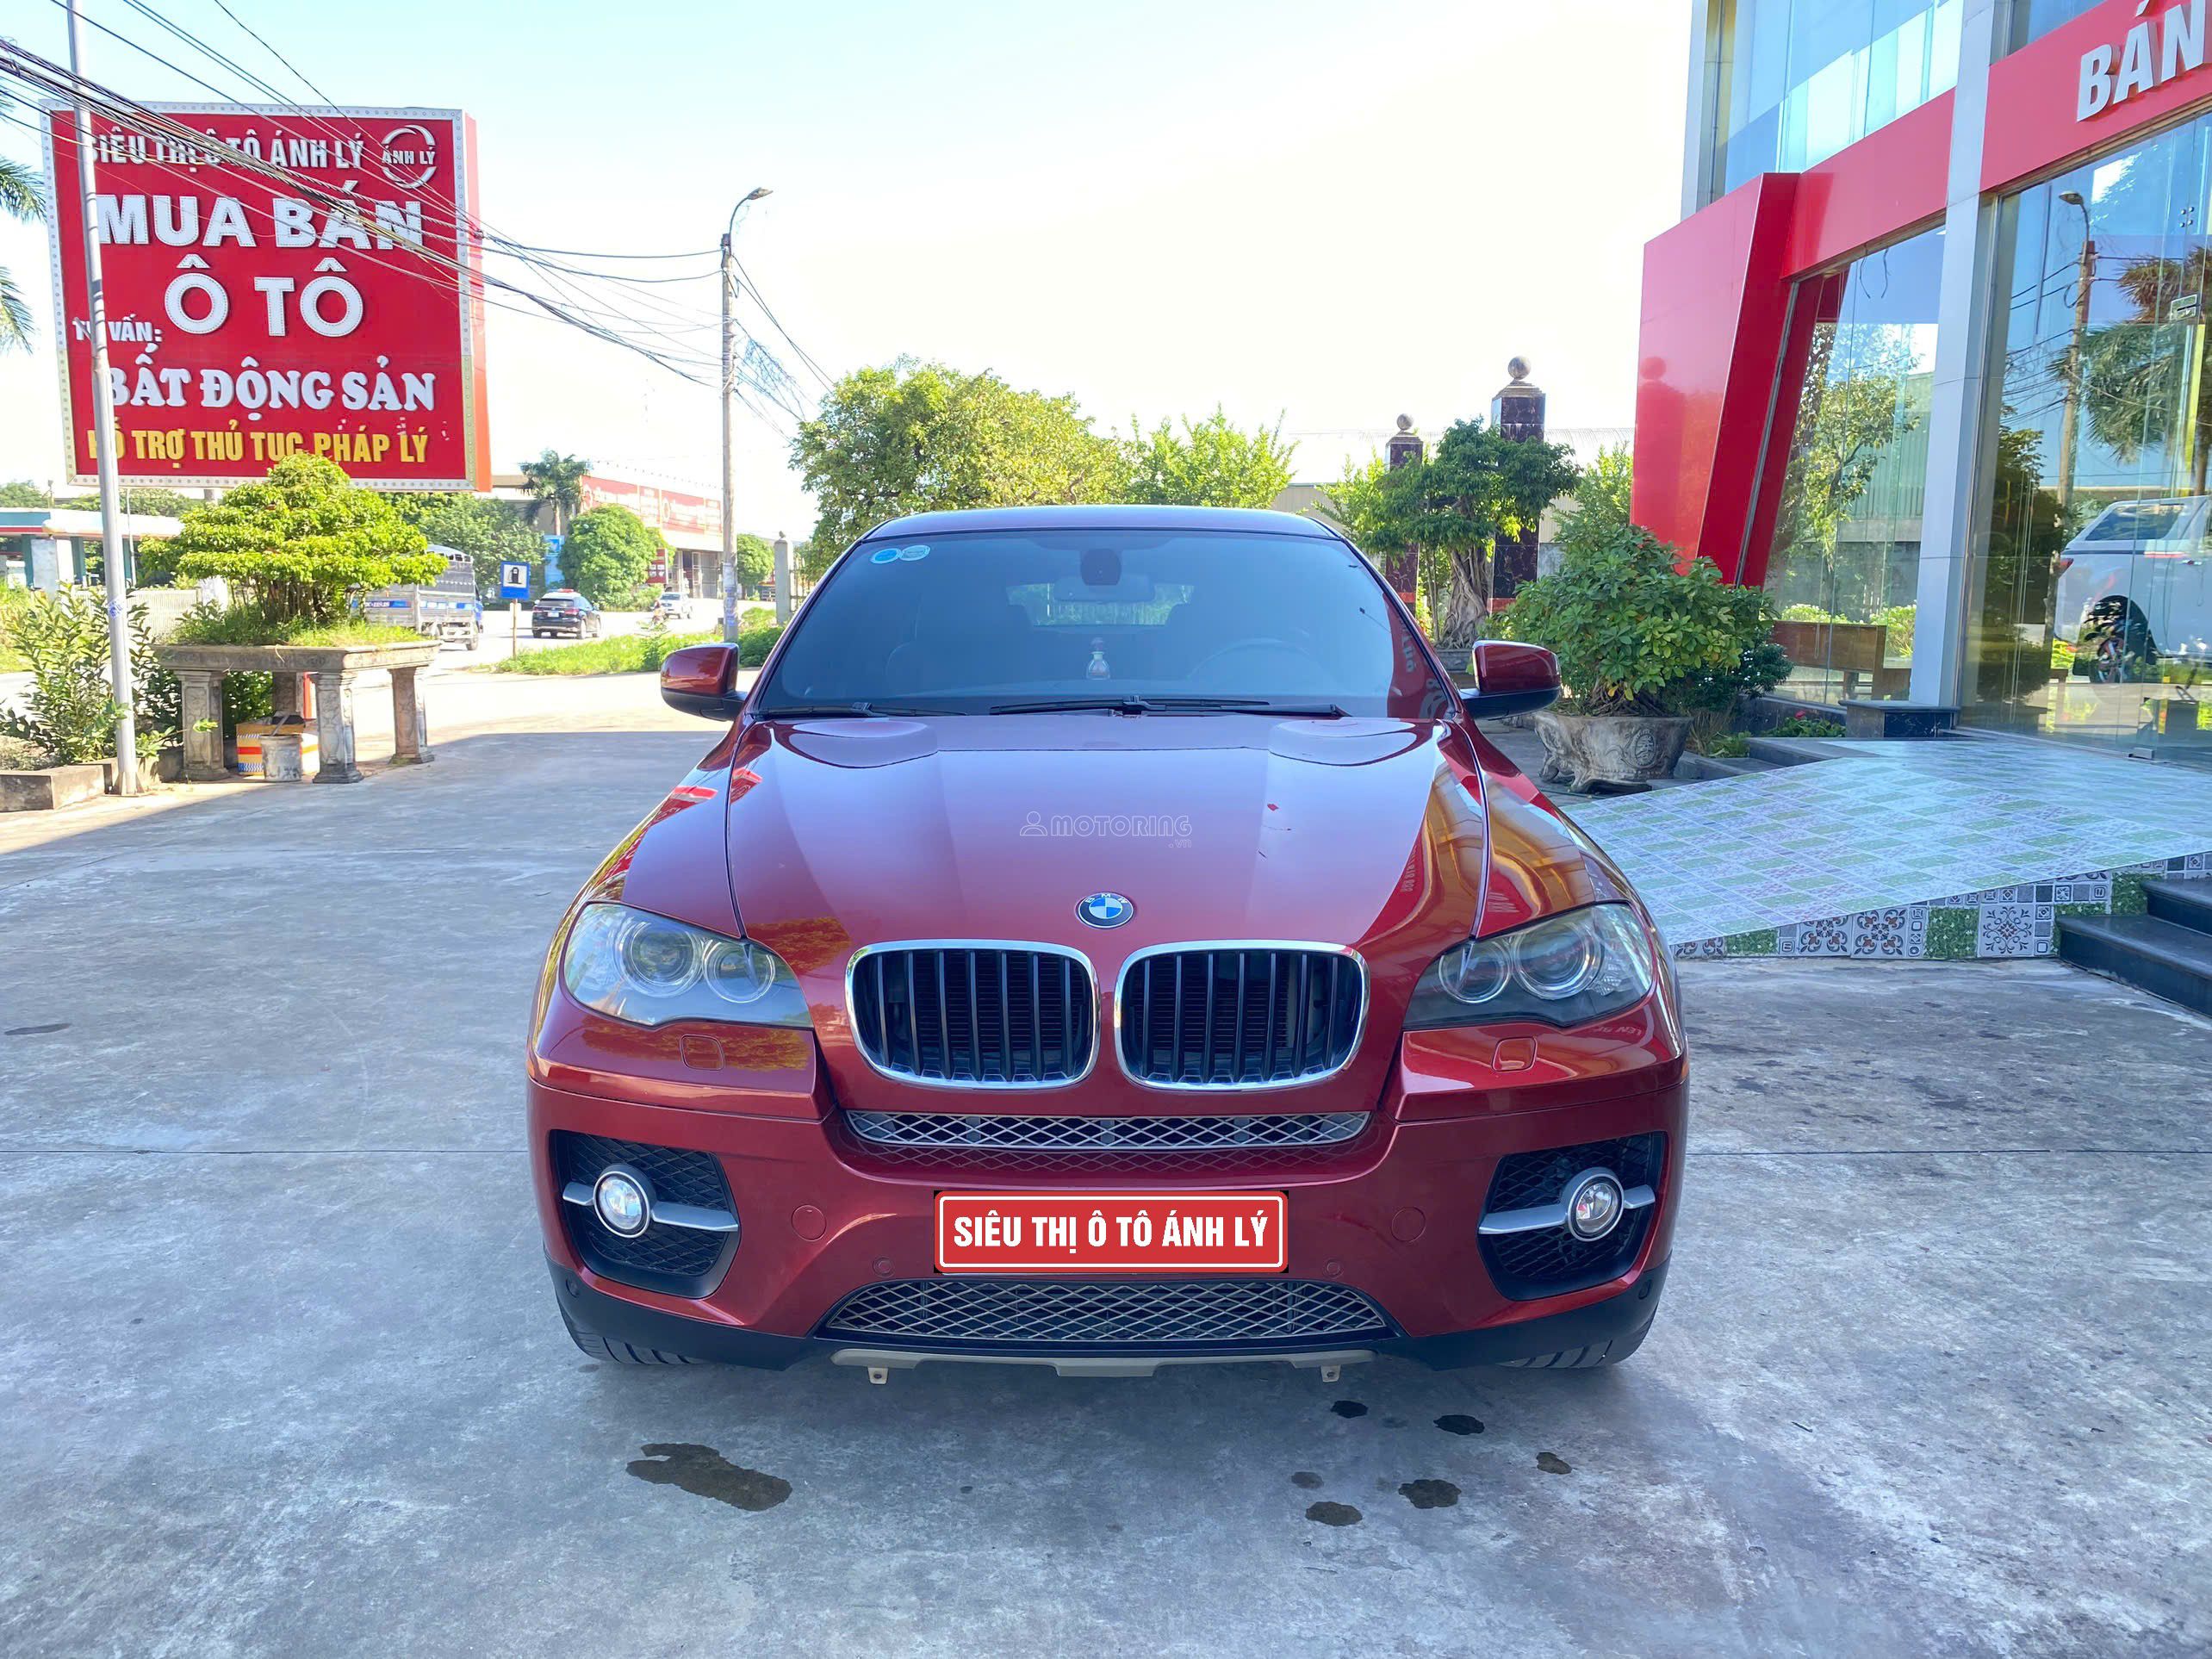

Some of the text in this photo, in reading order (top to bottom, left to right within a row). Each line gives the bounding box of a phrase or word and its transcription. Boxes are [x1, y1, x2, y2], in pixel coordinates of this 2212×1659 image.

[2076, 0, 2207, 121] BÁN
[270, 130, 327, 168] ÁNH
[335, 132, 363, 169] LÝ
[382, 145, 436, 165] ÁNH LÝ
[96, 179, 424, 249] MUA BÁN
[165, 253, 363, 337] Ô TÔ
[108, 314, 162, 342] VẤN:
[110, 343, 436, 421] BẤT ĐỘNG SẢN
[131, 428, 186, 468] TRỢ
[190, 419, 244, 461] THỦ
[314, 425, 390, 463] PHÁP
[400, 426, 428, 463] LÝ
